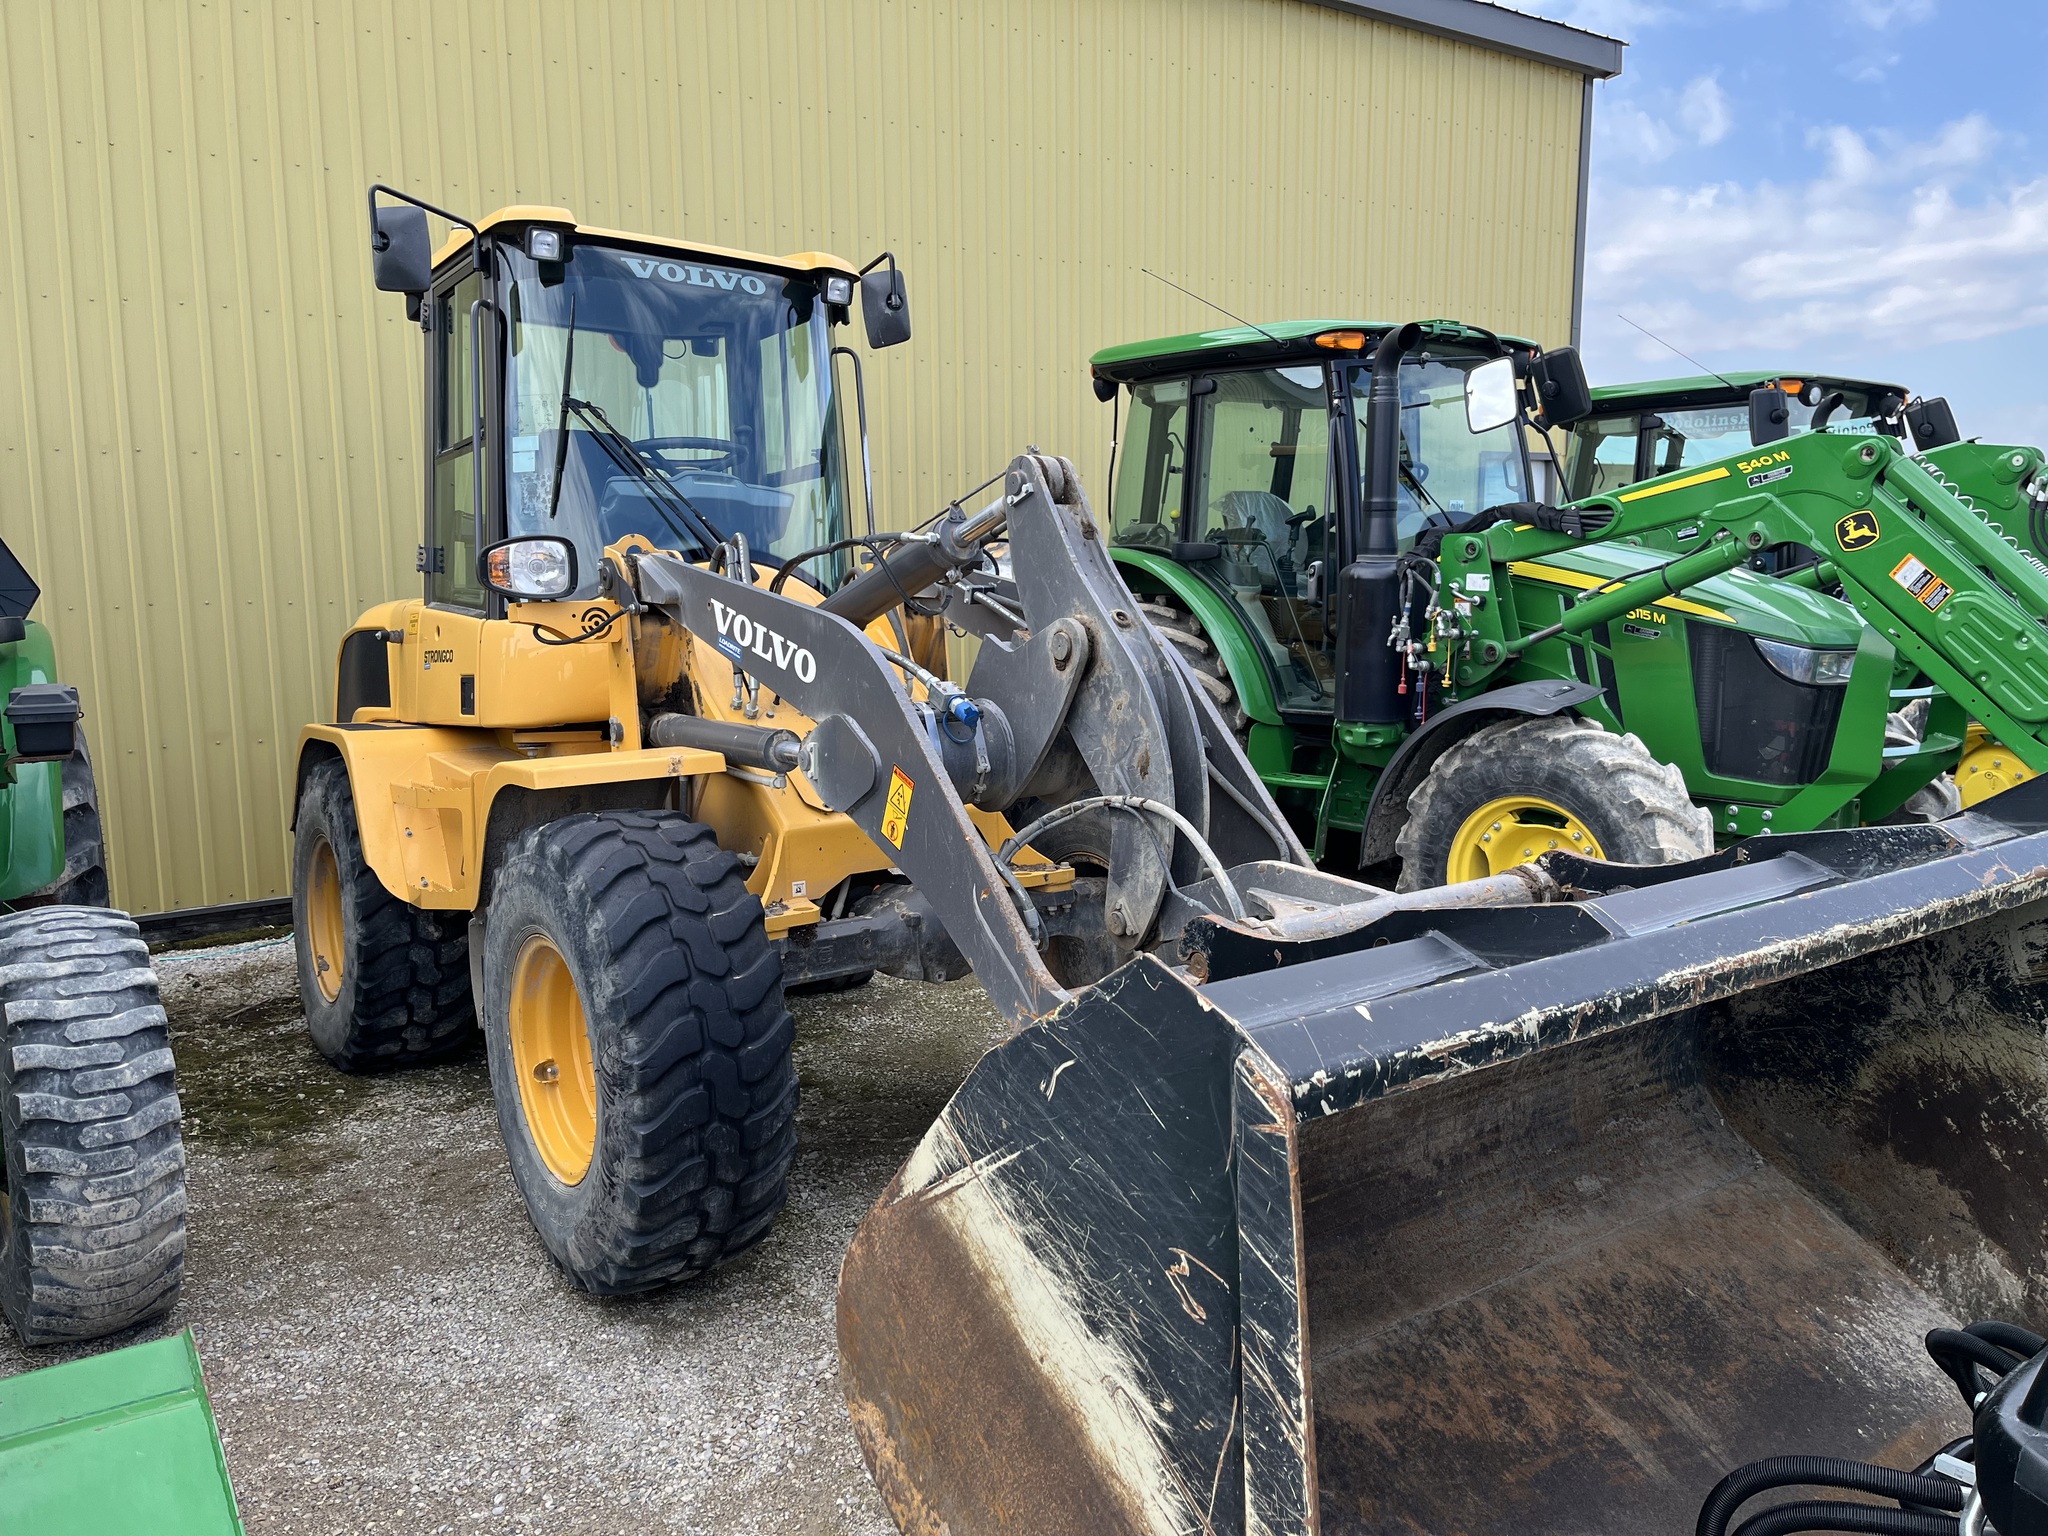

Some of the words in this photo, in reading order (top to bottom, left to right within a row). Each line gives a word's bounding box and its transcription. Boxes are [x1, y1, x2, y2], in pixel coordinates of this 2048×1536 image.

[621, 257, 766, 295] VOLVO
[1663, 412, 1749, 430] Podolinsk
[1737, 456, 1773, 474] 540
[1772, 450, 1791, 462] M
[1653, 612, 1666, 625] M
[711, 598, 817, 684] VOLVO
[424, 649, 454, 663] STRONGCO
